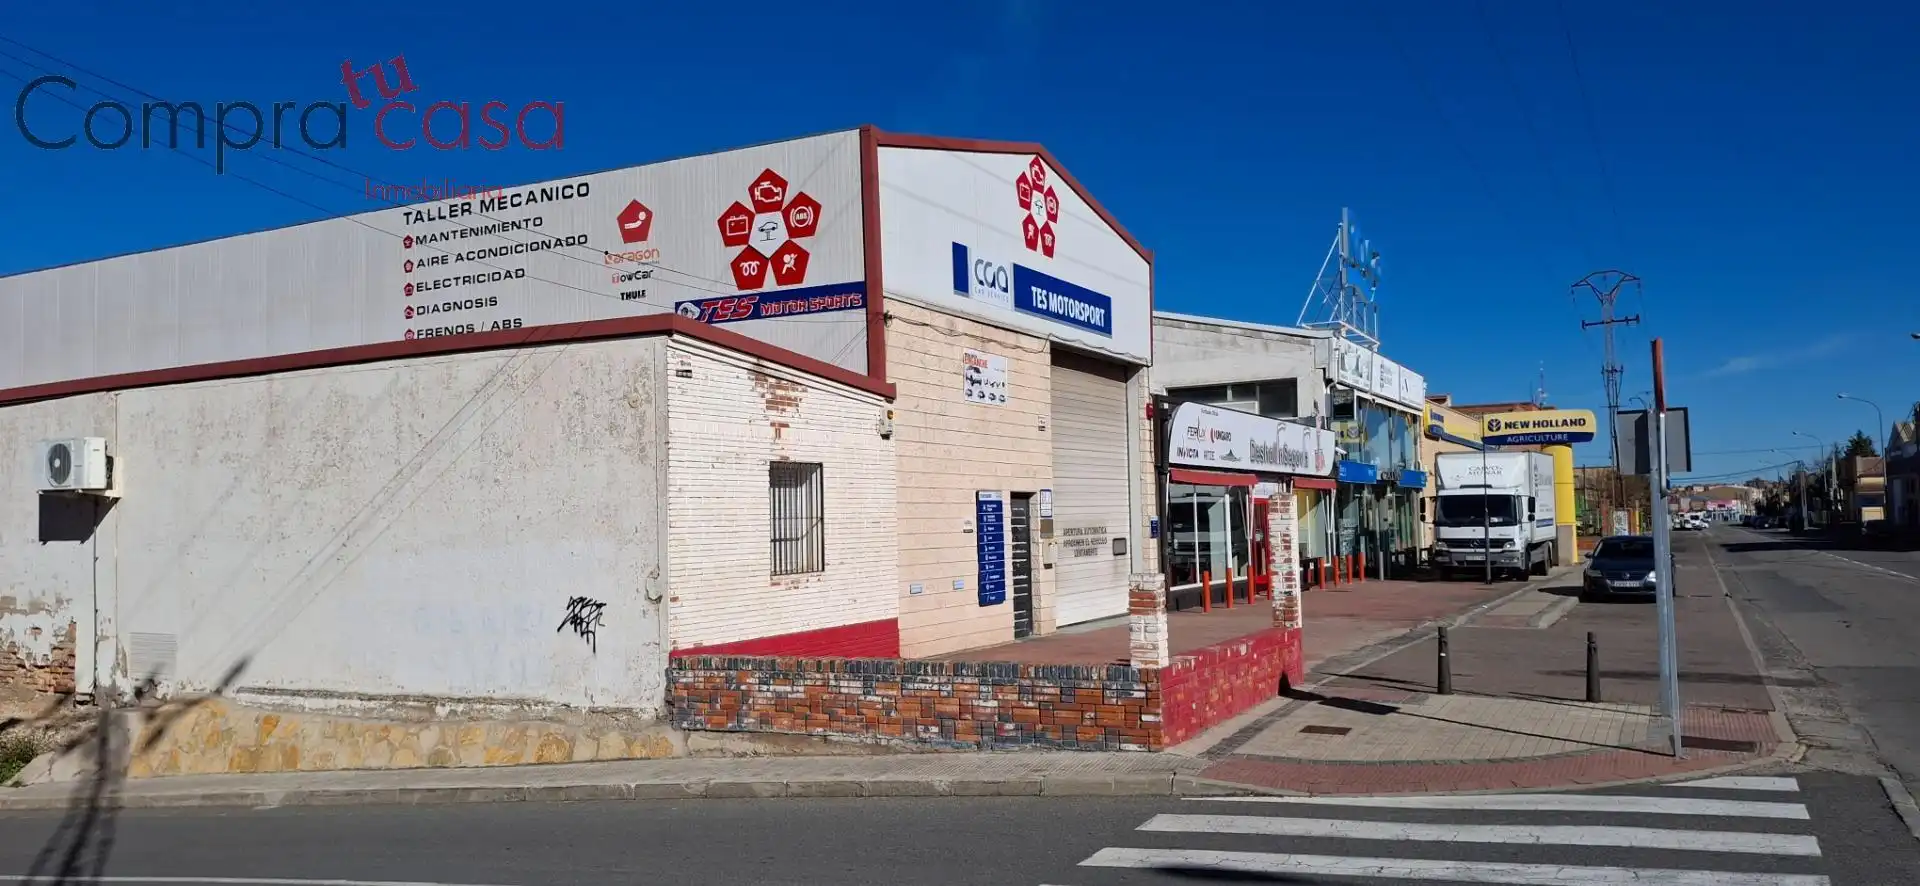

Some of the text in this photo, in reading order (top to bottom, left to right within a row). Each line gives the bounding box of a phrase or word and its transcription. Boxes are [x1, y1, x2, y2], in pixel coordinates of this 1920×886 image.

[403, 182, 590, 225] TALLER MECANICO
[415, 216, 543, 245] MANTENIMIENTO
[416, 234, 588, 269] AIRE ACONDICIONADO
[416, 268, 525, 292] ELECTRICIDAD
[416, 296, 498, 316] DIAGNOSIS
[620, 290, 646, 301] THULE
[1031, 286, 1106, 328] TES MOTORSPORT
[700, 294, 862, 323] TES MOTOR SPORTS
[416, 323, 475, 340] FRENOS
[491, 318, 523, 331] ABS
[1504, 417, 1587, 430] NEW HOLLAND
[1506, 433, 1569, 443] AGRICULTURE
